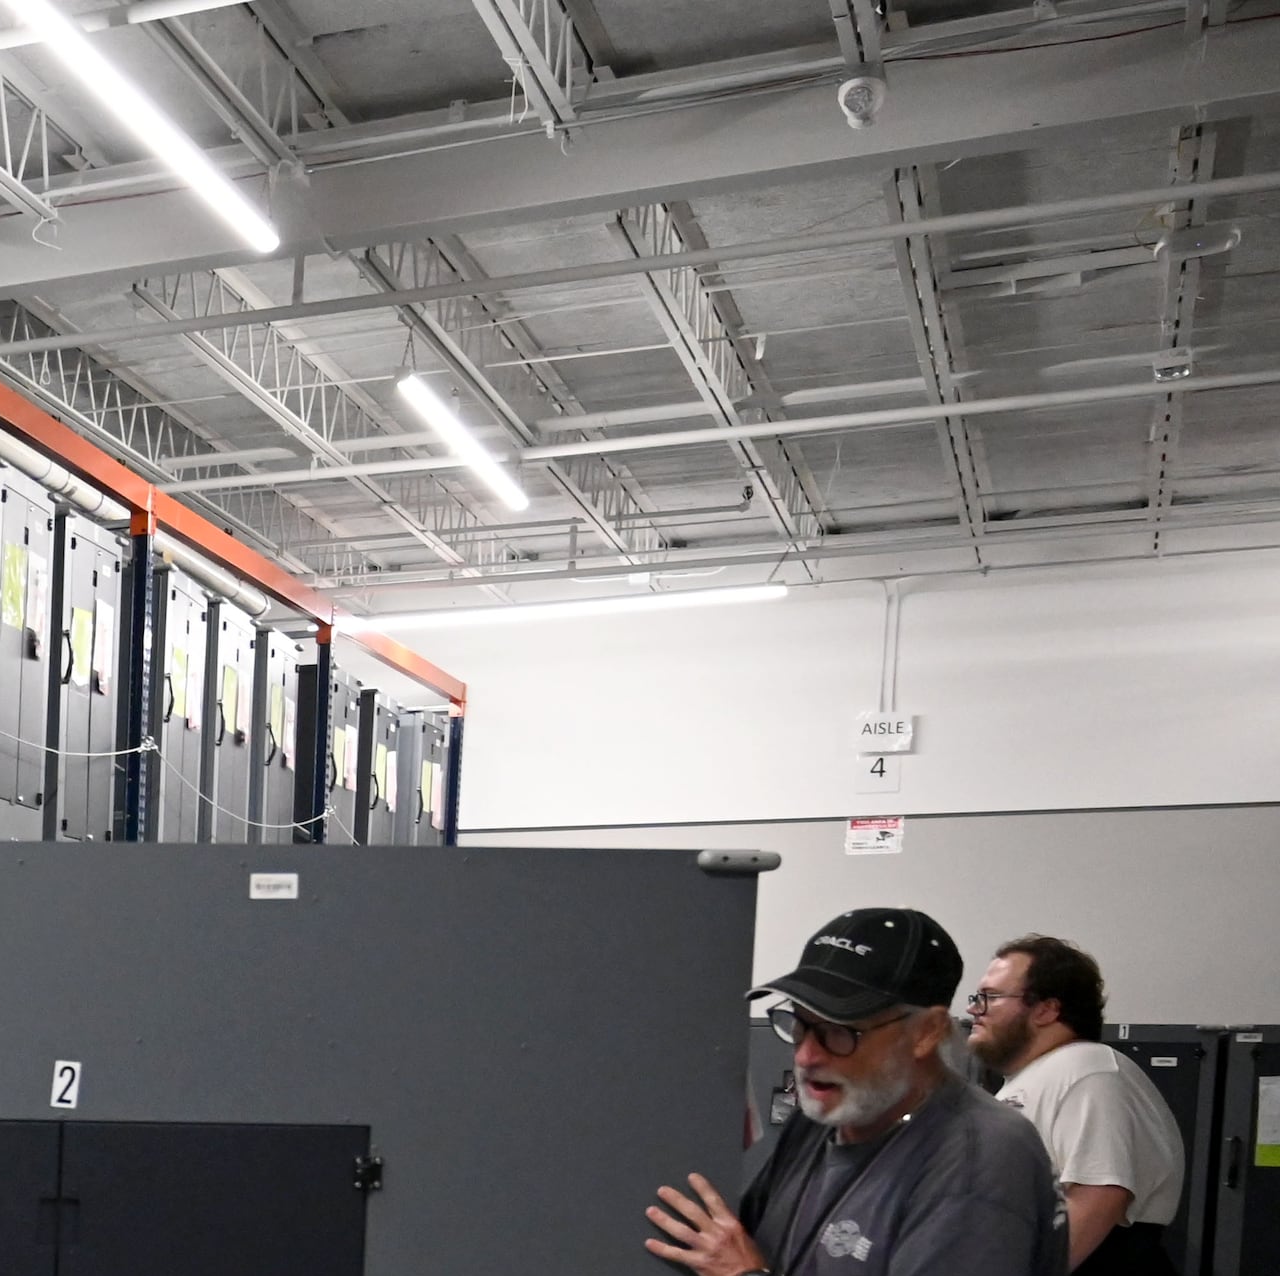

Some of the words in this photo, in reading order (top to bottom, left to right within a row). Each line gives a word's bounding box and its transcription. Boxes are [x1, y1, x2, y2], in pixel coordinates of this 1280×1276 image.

[861, 721, 905, 735] AISLE
[870, 757, 887, 778] 4
[56, 1065, 76, 1104] 2
